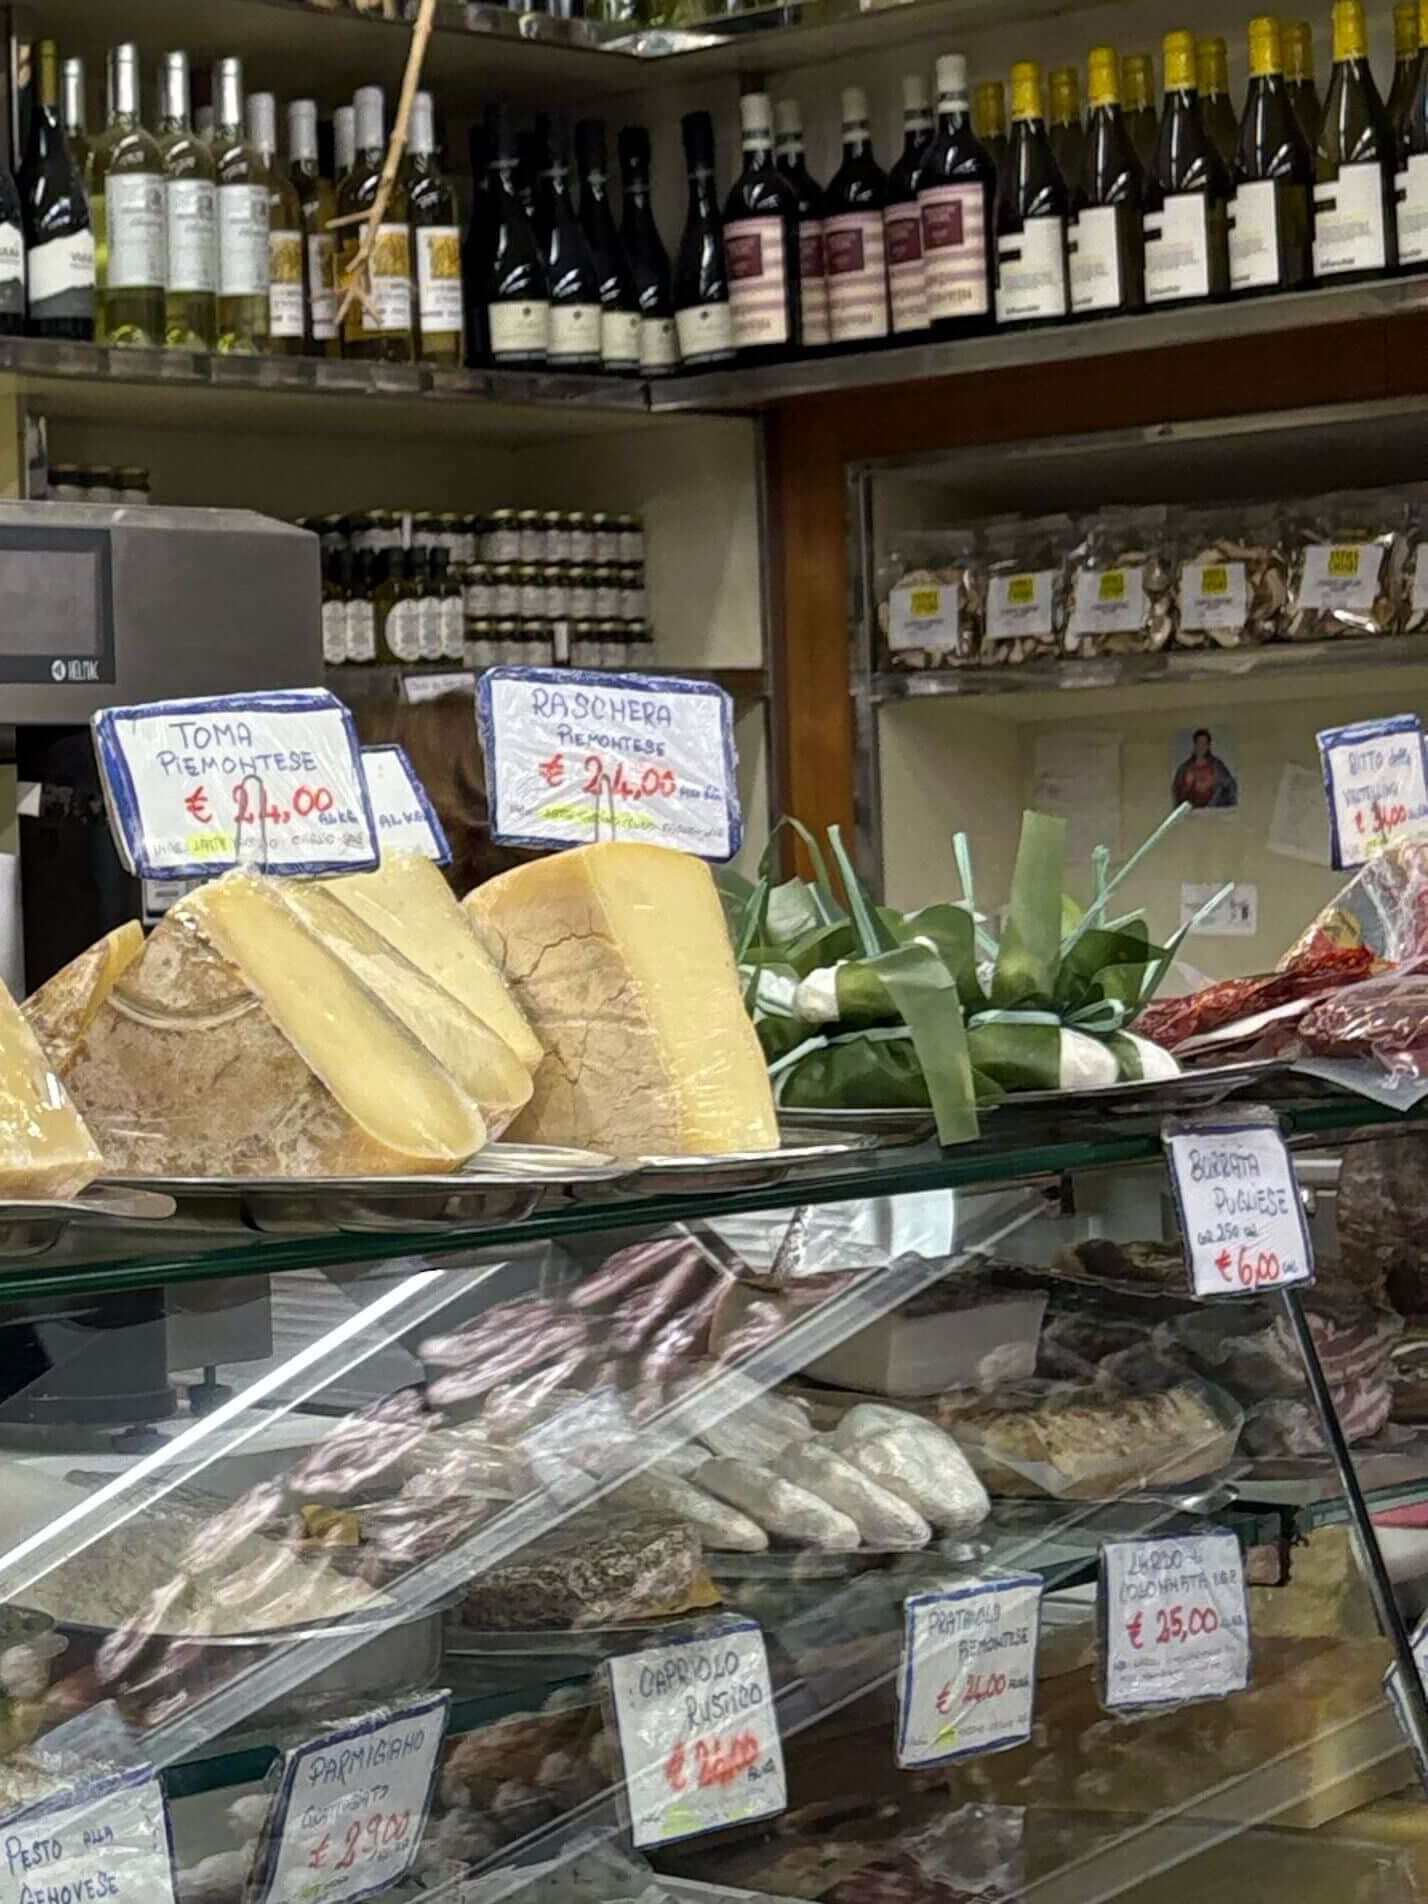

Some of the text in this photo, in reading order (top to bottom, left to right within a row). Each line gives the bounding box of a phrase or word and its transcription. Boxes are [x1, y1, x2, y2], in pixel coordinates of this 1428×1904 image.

[531, 688, 672, 728] RASCHERA
[169, 721, 253, 749] TOMA
[556, 723, 666, 757] PIEMONTESE
[156, 750, 318, 777] PIEMONTESE
[582, 755, 678, 801] 24,00
[184, 784, 334, 824] € 24,00
[1189, 1149, 1261, 1182] BURRATA
[1214, 1186, 1290, 1216] PUGLIESE
[1238, 1248, 1280, 1285] 6,00
[1155, 1607, 1220, 1644] 25,00
[5, 1834, 63, 1876] PESTO
